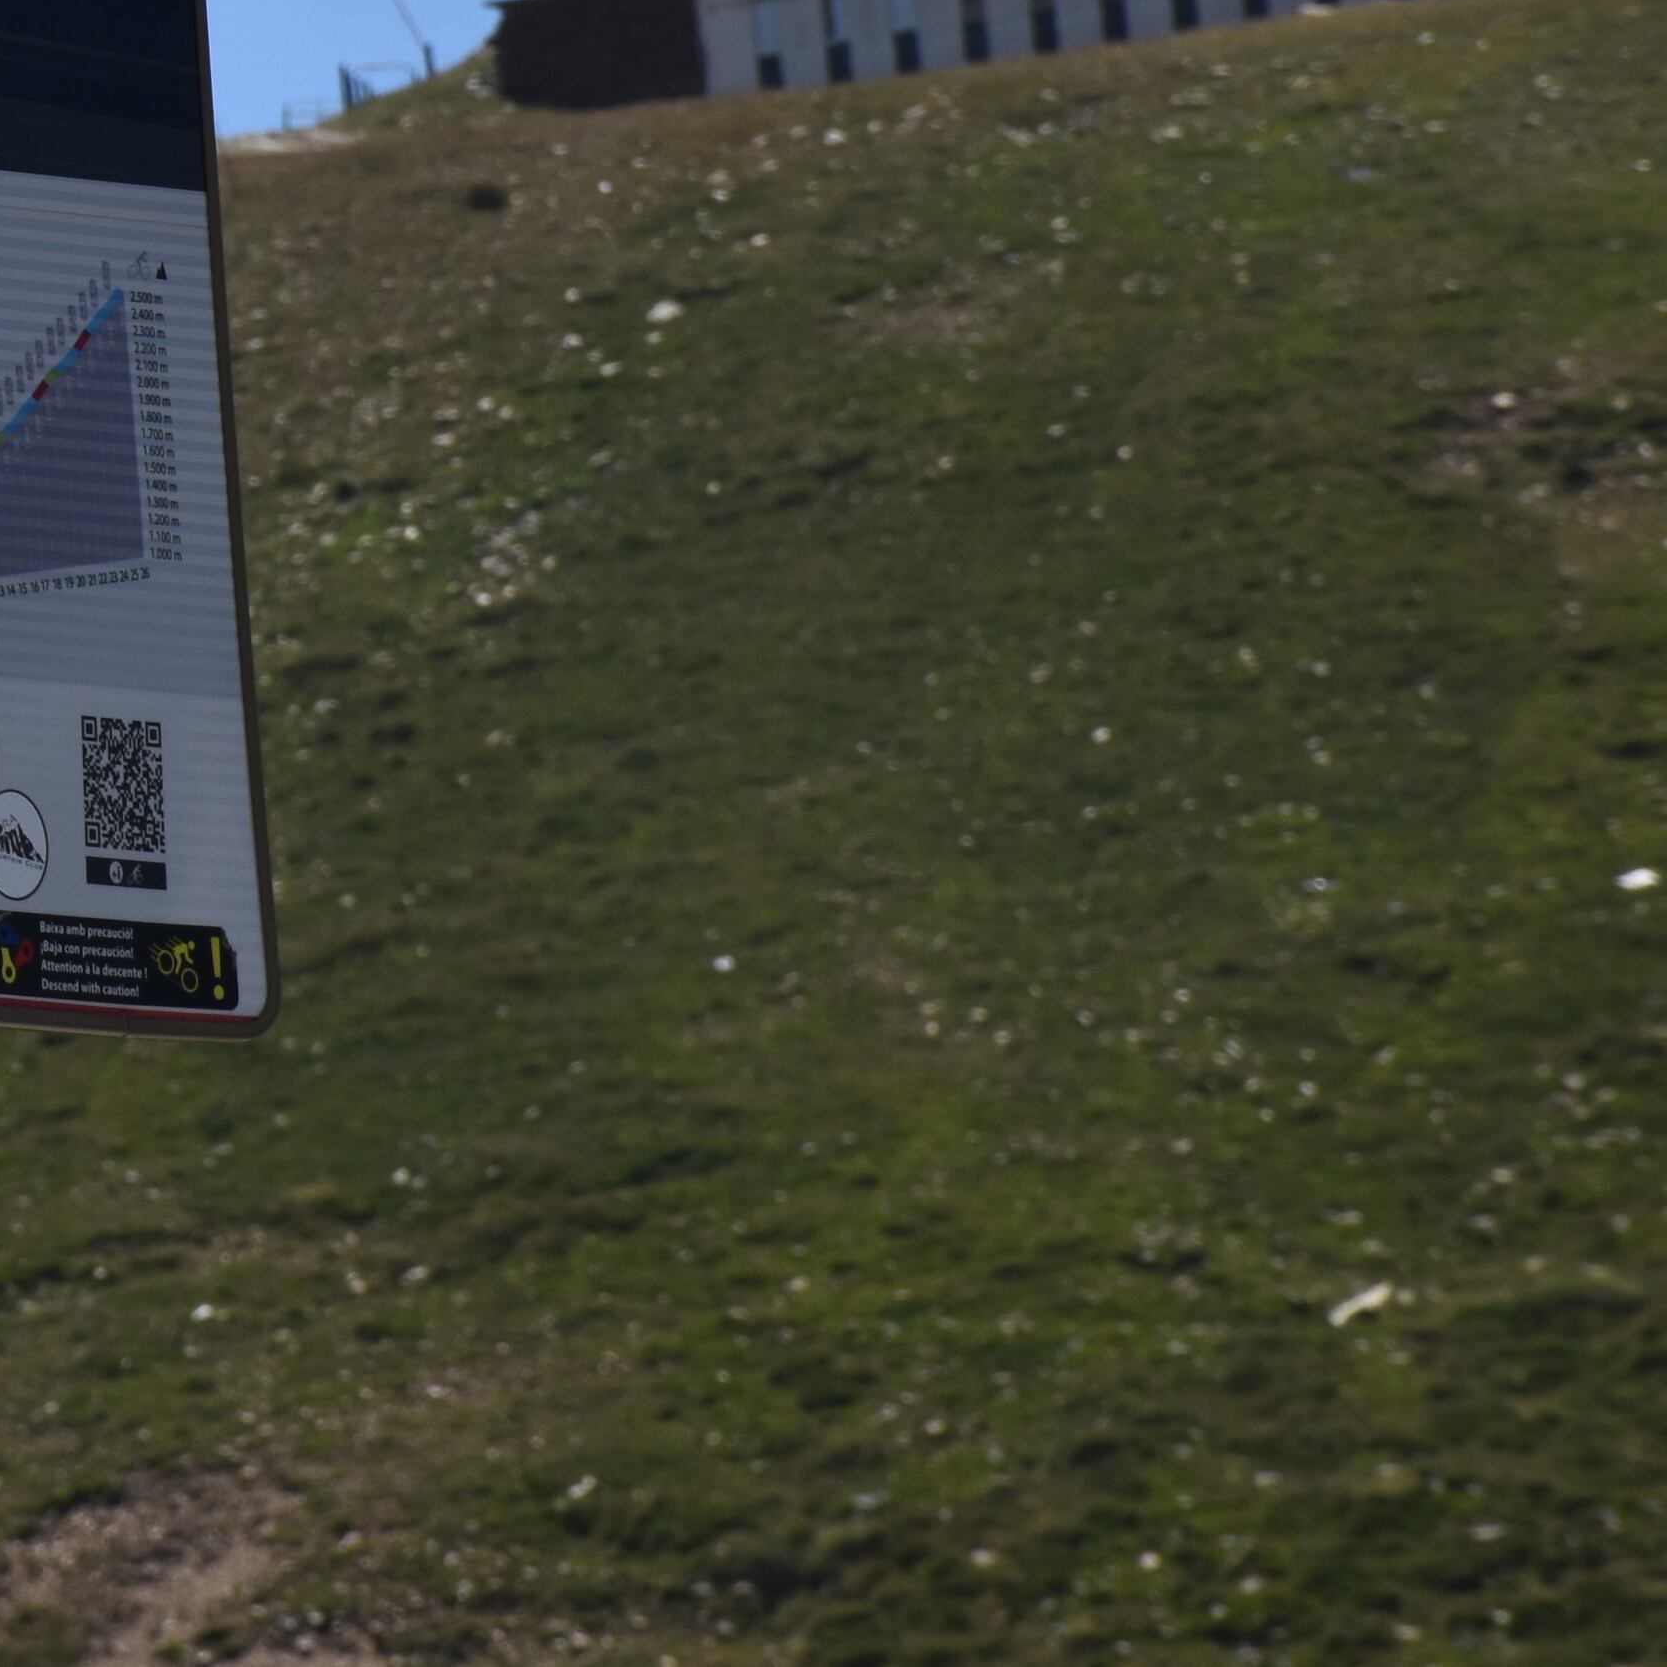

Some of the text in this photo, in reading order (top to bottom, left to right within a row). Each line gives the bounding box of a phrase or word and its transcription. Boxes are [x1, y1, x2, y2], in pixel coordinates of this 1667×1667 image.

[130, 291, 163, 305] 2.500 m
[131, 308, 164, 322] 2.400 m
[133, 325, 165, 339] 2.300 m
[134, 342, 167, 356] 2.200 m
[135, 359, 168, 373] 2.100 m
[137, 376, 169, 390] 2.000 m
[139, 393, 171, 407] 1.900 m
[140, 410, 172, 424] 1.800 m
[141, 427, 174, 441] 1.700 m
[143, 444, 175, 458] 1.600 m
[144, 461, 176, 475] 1.500 m
[145, 479, 177, 493] 1.400 m
[147, 496, 179, 510] 1.300 m
[148, 513, 180, 527] 1.200 m
[149, 530, 181, 544] 1.100 m
[150, 547, 182, 561] 1.000 m
[7, 585, 16, 596] 14
[19, 583, 28, 595] 15
[31, 581, 40, 593] 16
[41, 580, 50, 592] 17
[53, 578, 62, 590] 18
[65, 577, 74, 589] 19
[76, 575, 86, 587] 20
[88, 574, 96, 585] 21
[99, 573, 108, 584] 22
[109, 571, 119, 584] 23
[120, 570, 129, 582] 24
[130, 569, 139, 580] 25
[141, 567, 150, 579] 26
[39, 920, 134, 940] Baixa amb precaució!
[40, 940, 63, 954] ¡Baja
[64, 945, 81, 955] con
[40, 960, 83, 974] Attention
[92, 963, 101, 975] la
[102, 964, 143, 979] descente
[41, 978, 139, 997] Descend with caution!
